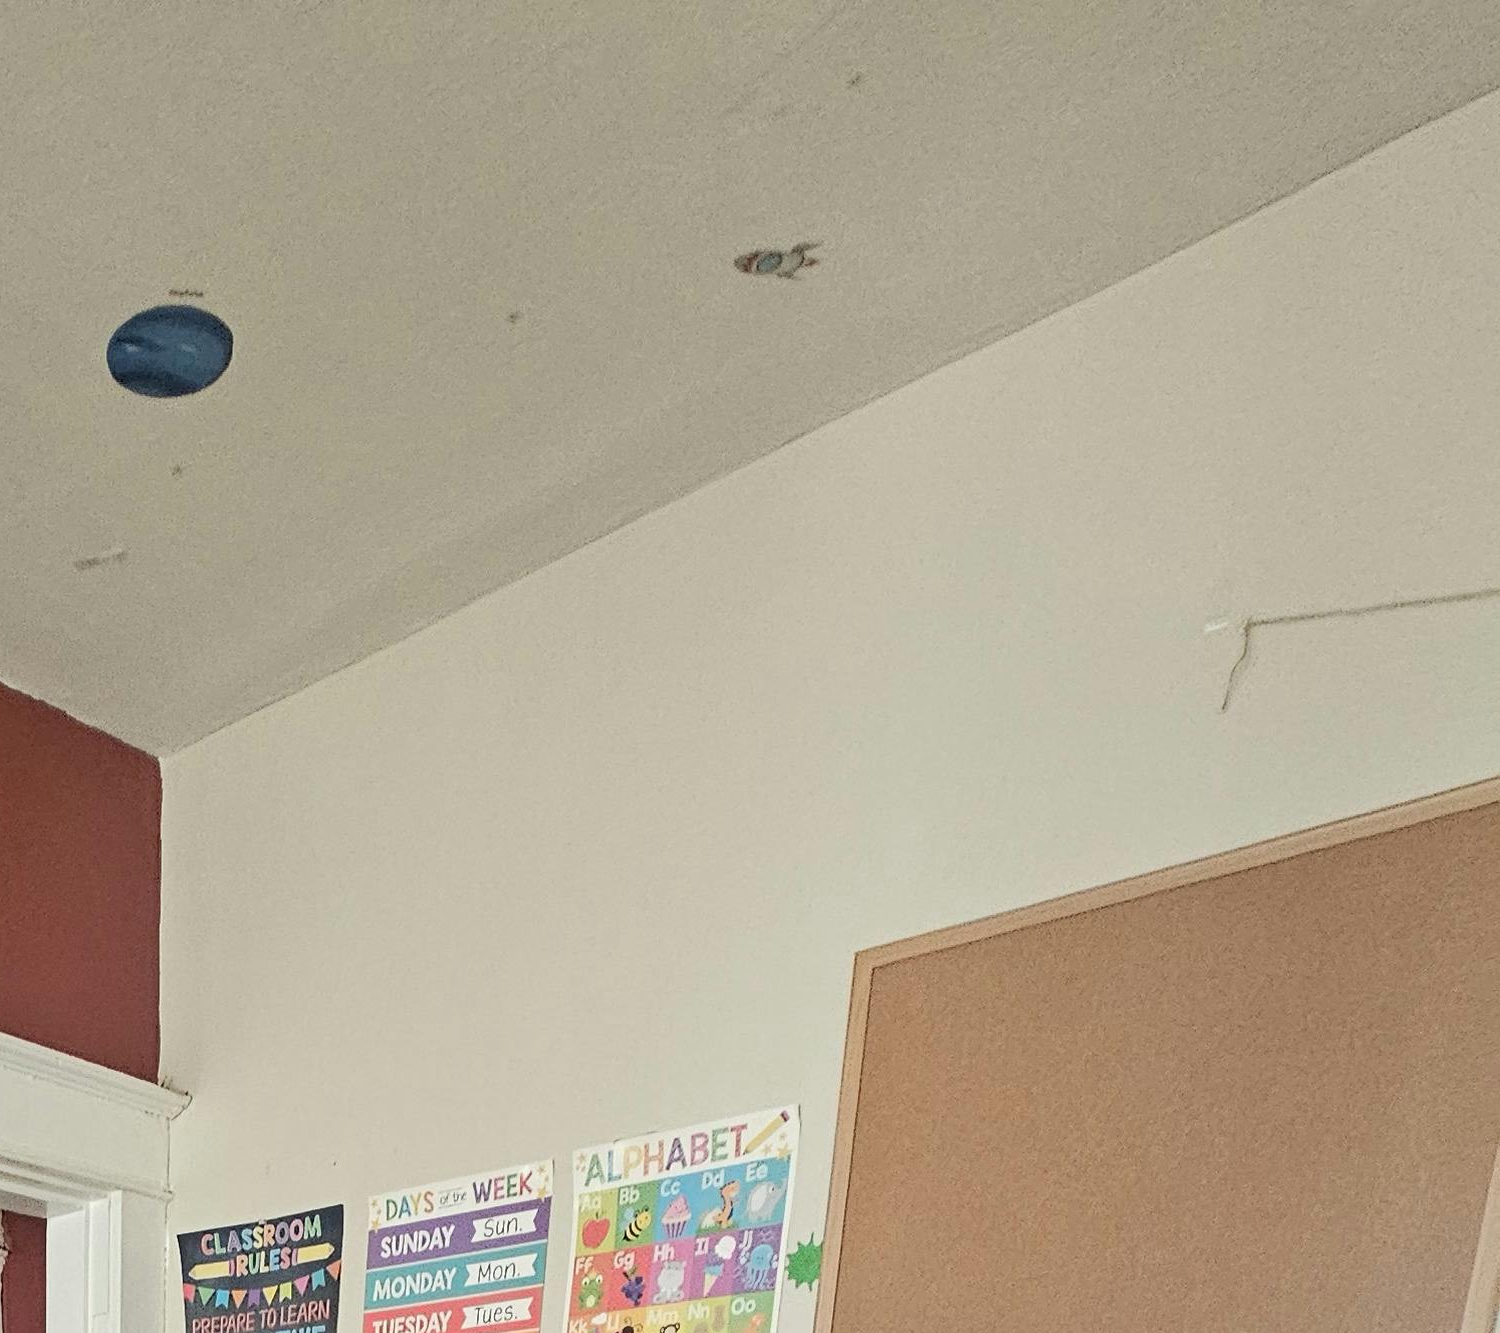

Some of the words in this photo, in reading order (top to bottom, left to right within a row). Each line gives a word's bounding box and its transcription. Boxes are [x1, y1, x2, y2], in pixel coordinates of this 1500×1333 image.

[585, 1124, 748, 1187] ALPHABET
[385, 1192, 434, 1220] DAYS
[472, 1171, 533, 1204] WEEK
[201, 1215, 322, 1256] CLASSROOM
[380, 1224, 455, 1259] SUNDAY
[483, 1216, 522, 1237] Sun.
[373, 1267, 456, 1301] MONDAY
[477, 1263, 520, 1282] Mon.
[260, 1310, 276, 1328] TO
[279, 1299, 330, 1325] LEARN
[475, 1306, 518, 1324] Tues.
